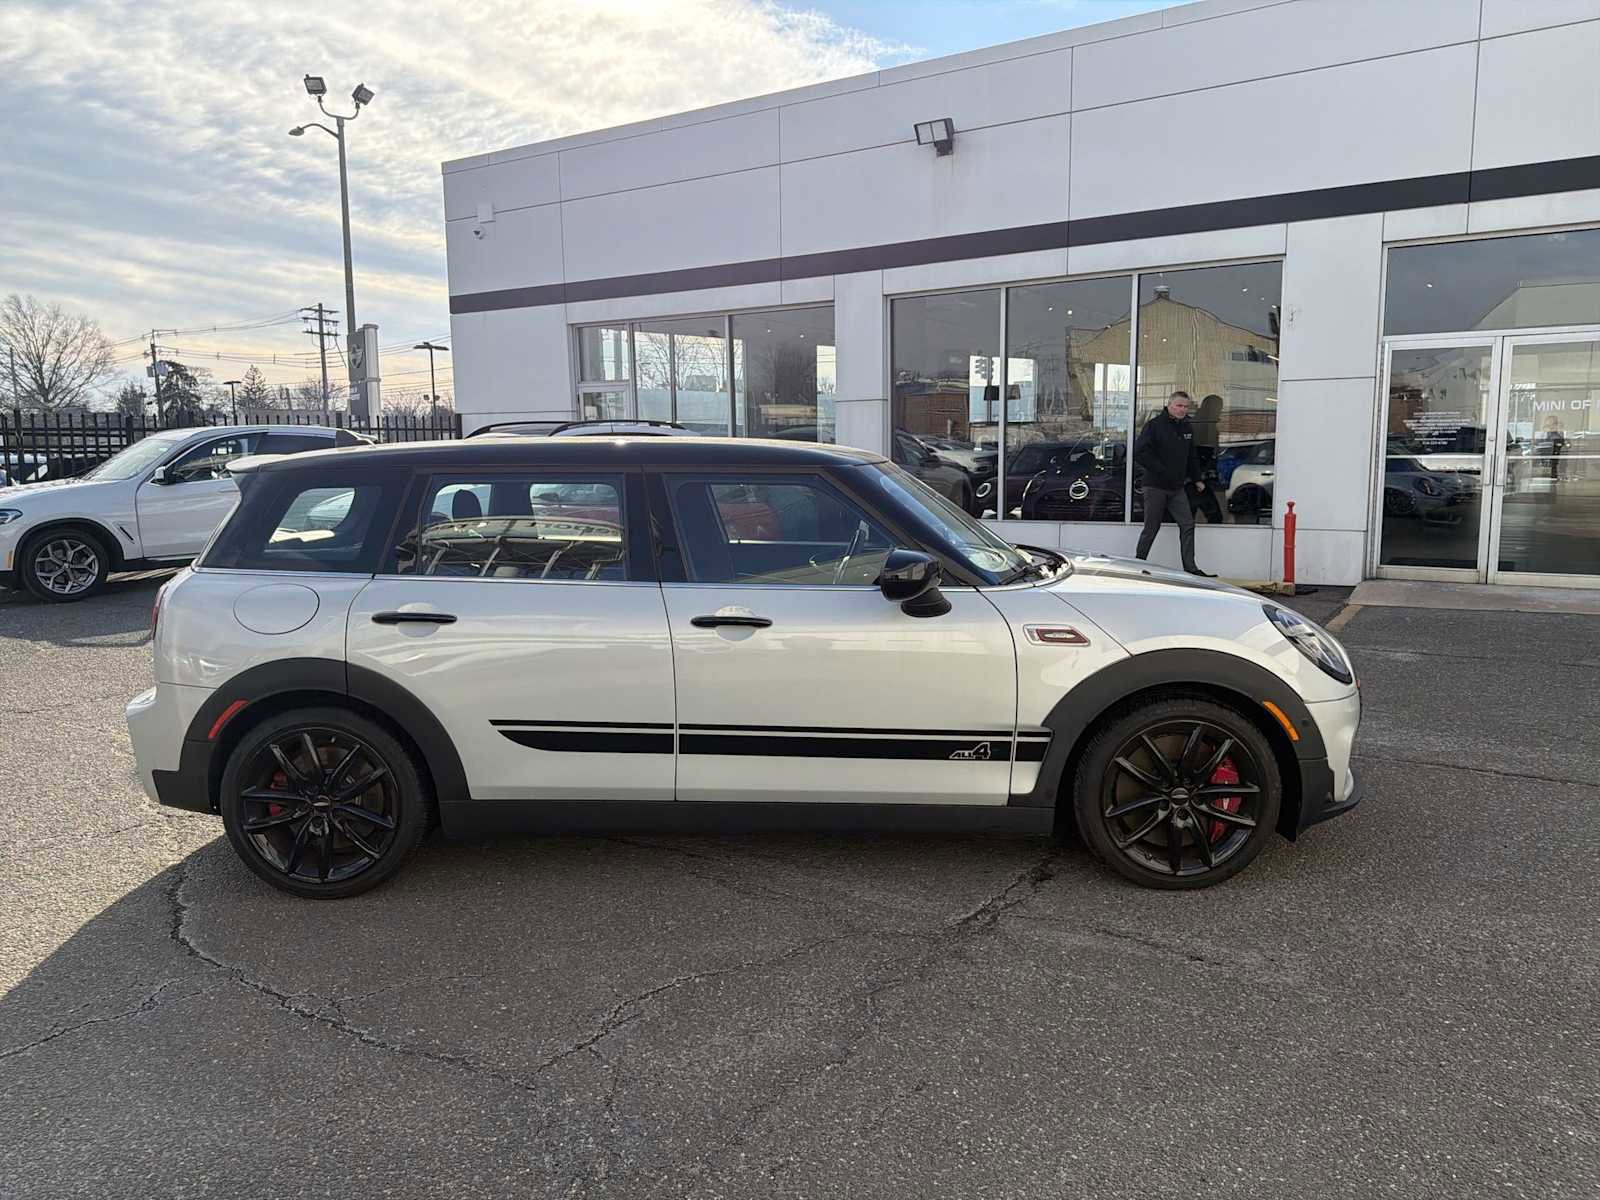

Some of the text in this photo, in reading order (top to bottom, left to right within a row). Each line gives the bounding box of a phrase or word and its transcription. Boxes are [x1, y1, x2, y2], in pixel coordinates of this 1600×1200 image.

[1535, 400, 1565, 411] MINI
[1570, 400, 1591, 410] OF
[948, 741, 991, 760] ALL4
